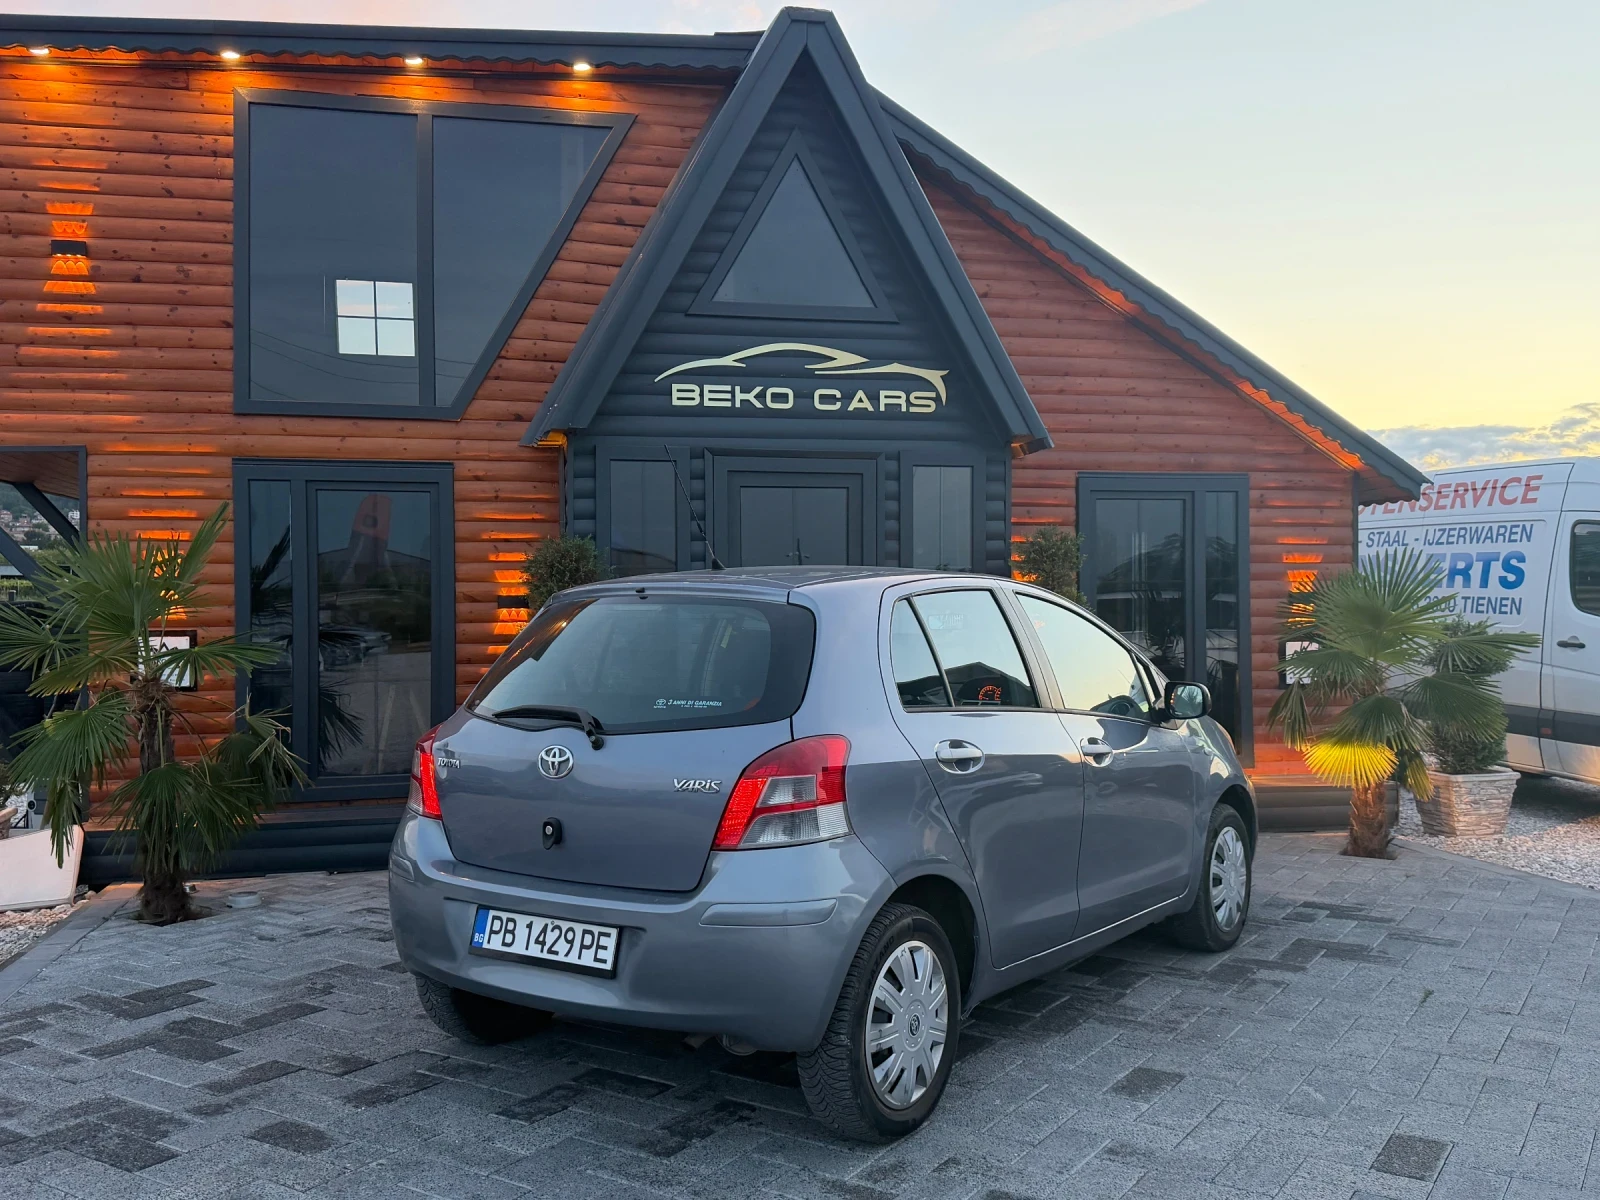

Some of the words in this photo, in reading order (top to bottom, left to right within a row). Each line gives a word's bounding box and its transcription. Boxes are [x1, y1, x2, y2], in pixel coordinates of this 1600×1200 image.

[671, 383, 794, 410] BEKO
[813, 389, 937, 413] CARS
[1358, 474, 1543, 516] SERVICE
[1365, 528, 1409, 548] STAAL
[1423, 523, 1534, 546] IJZERWAREN
[1358, 550, 1527, 590] ERTS
[1461, 596, 1523, 615] TIENEN
[437, 757, 460, 769] TOYOTA
[473, 932, 484, 943] BG
[486, 914, 517, 947] PB
[524, 920, 576, 957] 1429
[577, 928, 612, 964] PE
